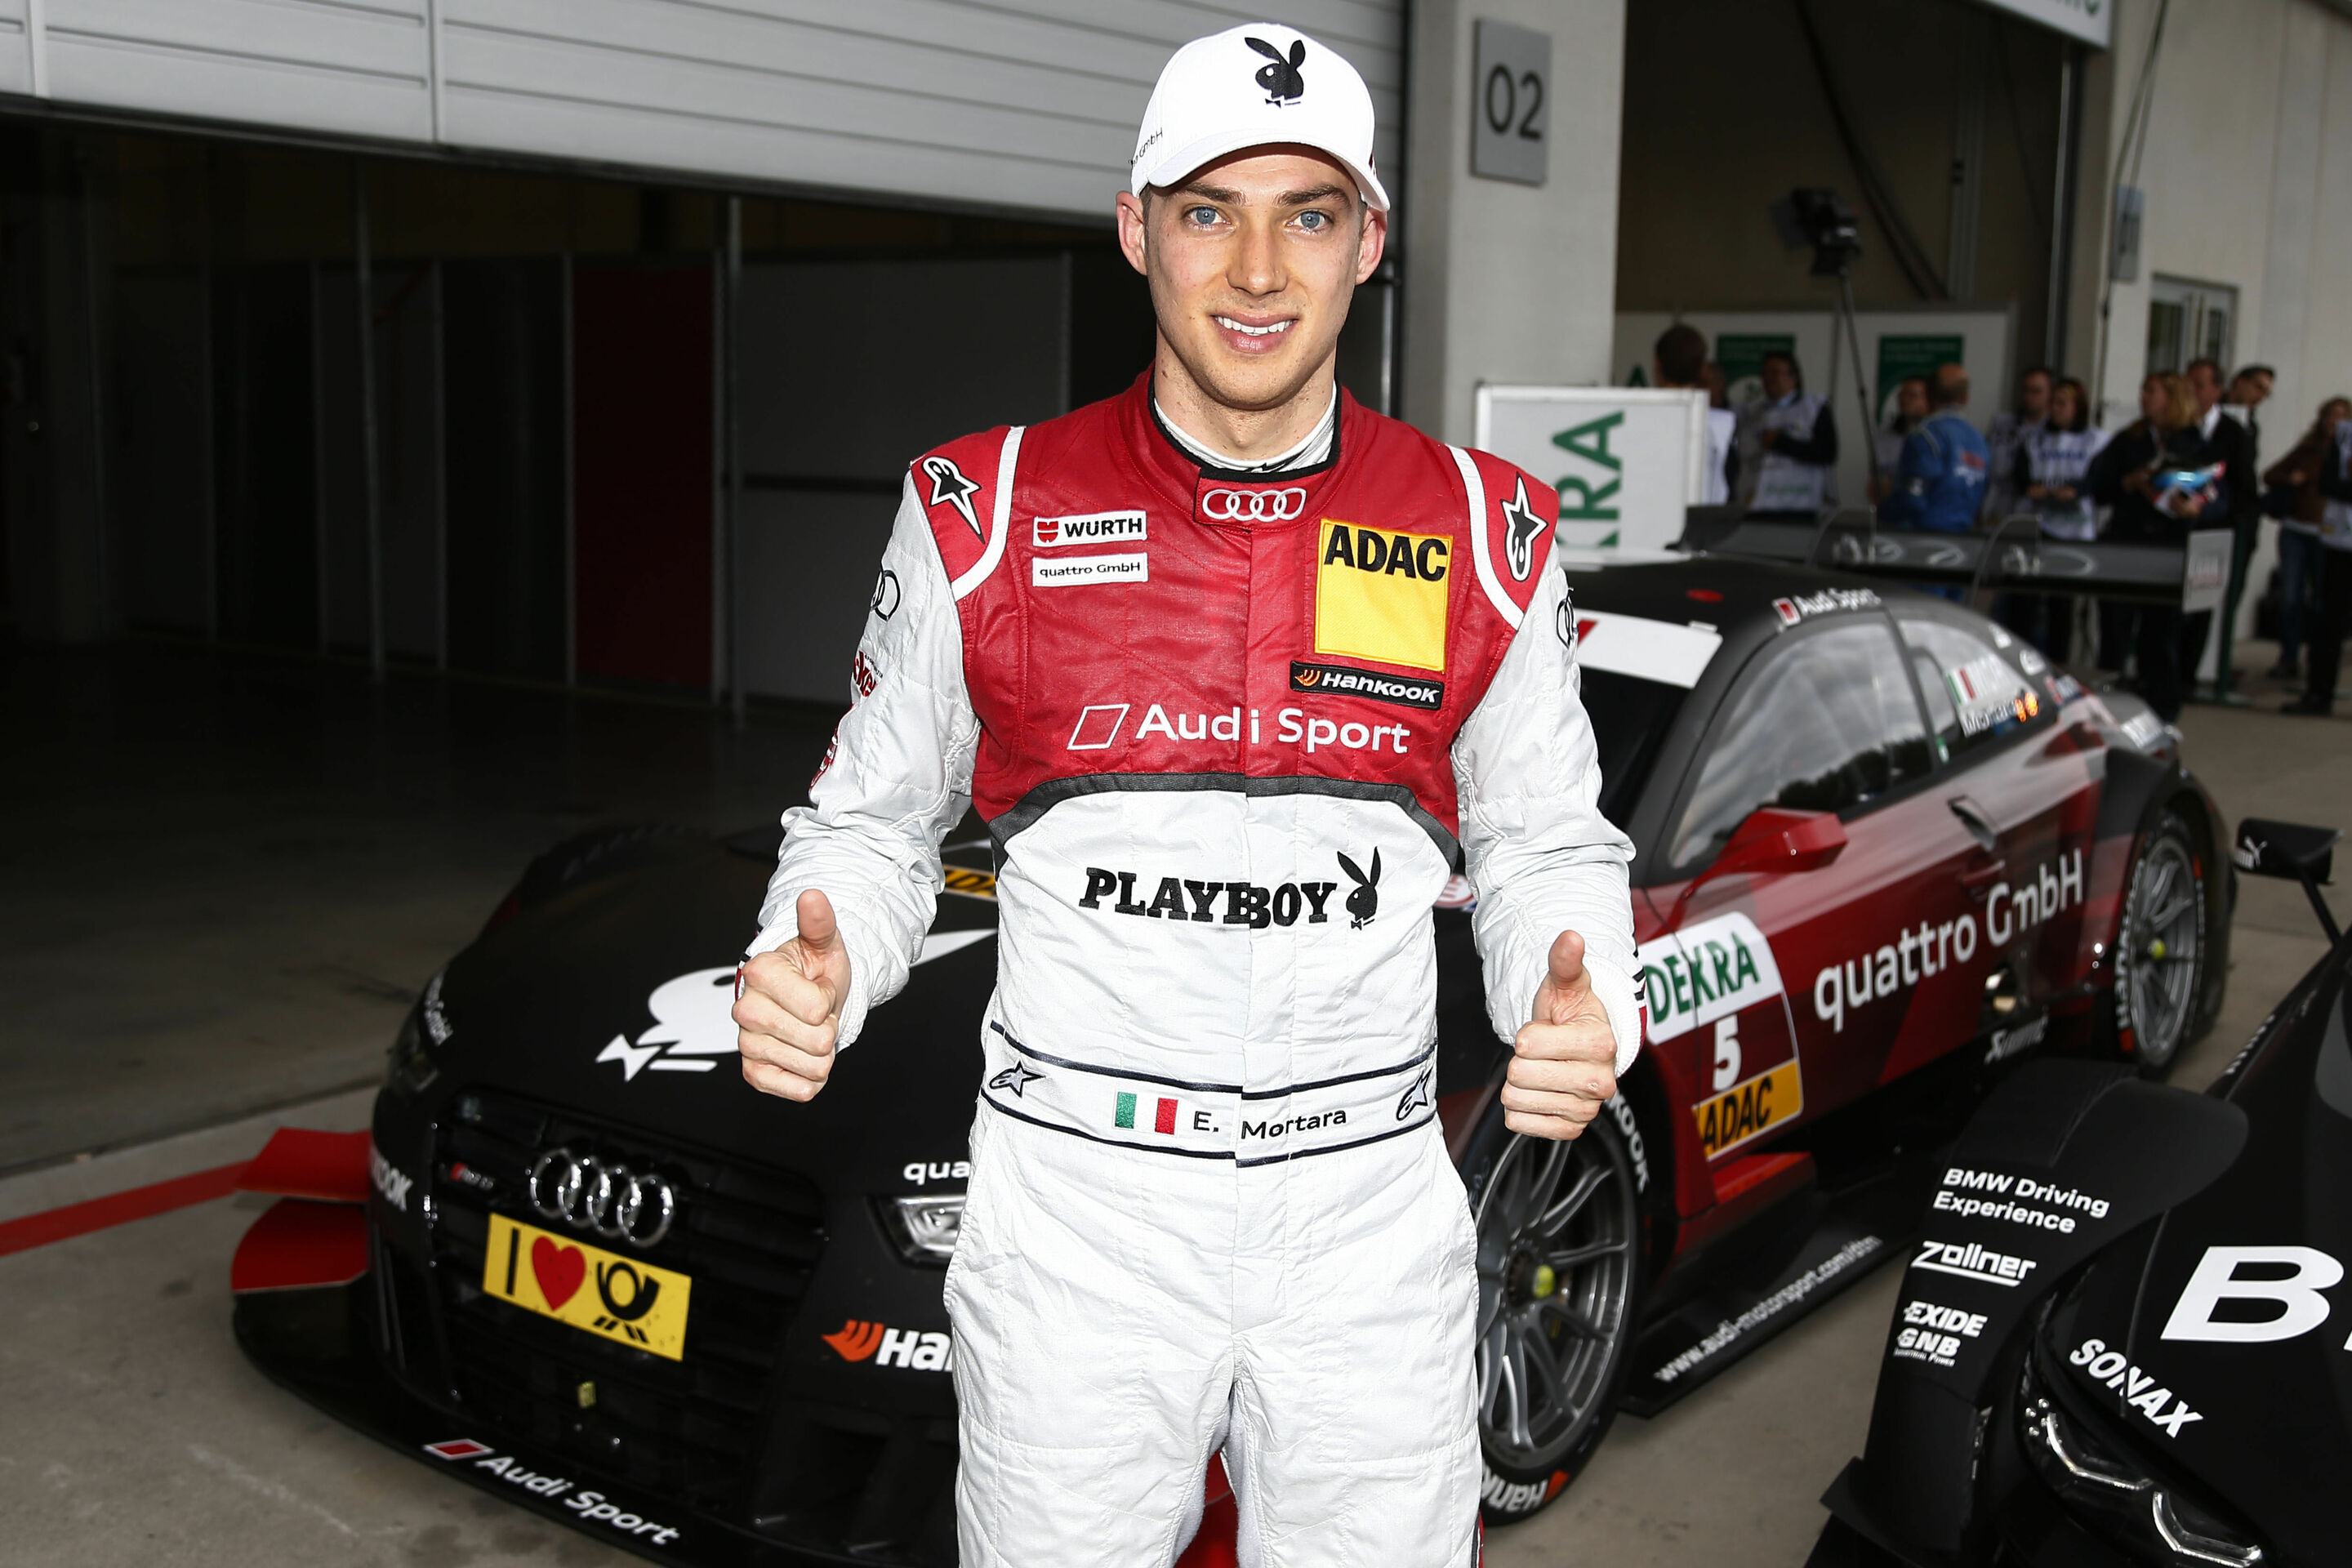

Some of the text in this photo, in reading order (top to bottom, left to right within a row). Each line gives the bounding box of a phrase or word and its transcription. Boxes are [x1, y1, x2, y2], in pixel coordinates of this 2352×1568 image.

[1486, 62, 1544, 143] 02
[1039, 561, 1141, 579] quattro GmbH
[1324, 524, 1448, 581] ADAC
[1135, 703, 1411, 755] Audi Sport
[1078, 866, 1338, 929] PLAYBOY
[1813, 913, 1978, 1035] quattro
[1986, 847, 2083, 947] GmbH
[1644, 931, 1761, 1026] DEKRA
[1712, 1013, 1742, 1092] 5
[1193, 1109, 1348, 1140] E. Mortara
[1704, 1075, 1773, 1152] ADAC
[903, 1160, 971, 1186] qua
[1943, 1167, 2110, 1219] BMW Driving
[1932, 1190, 2077, 1234] Experience
[1904, 1300, 1989, 1338] EXIDE
[2160, 1245, 2352, 1352] B
[1897, 1327, 1962, 1357] GNB
[2069, 1339, 2204, 1439] SONAX
[474, 1455, 680, 1545] Audi Sport
